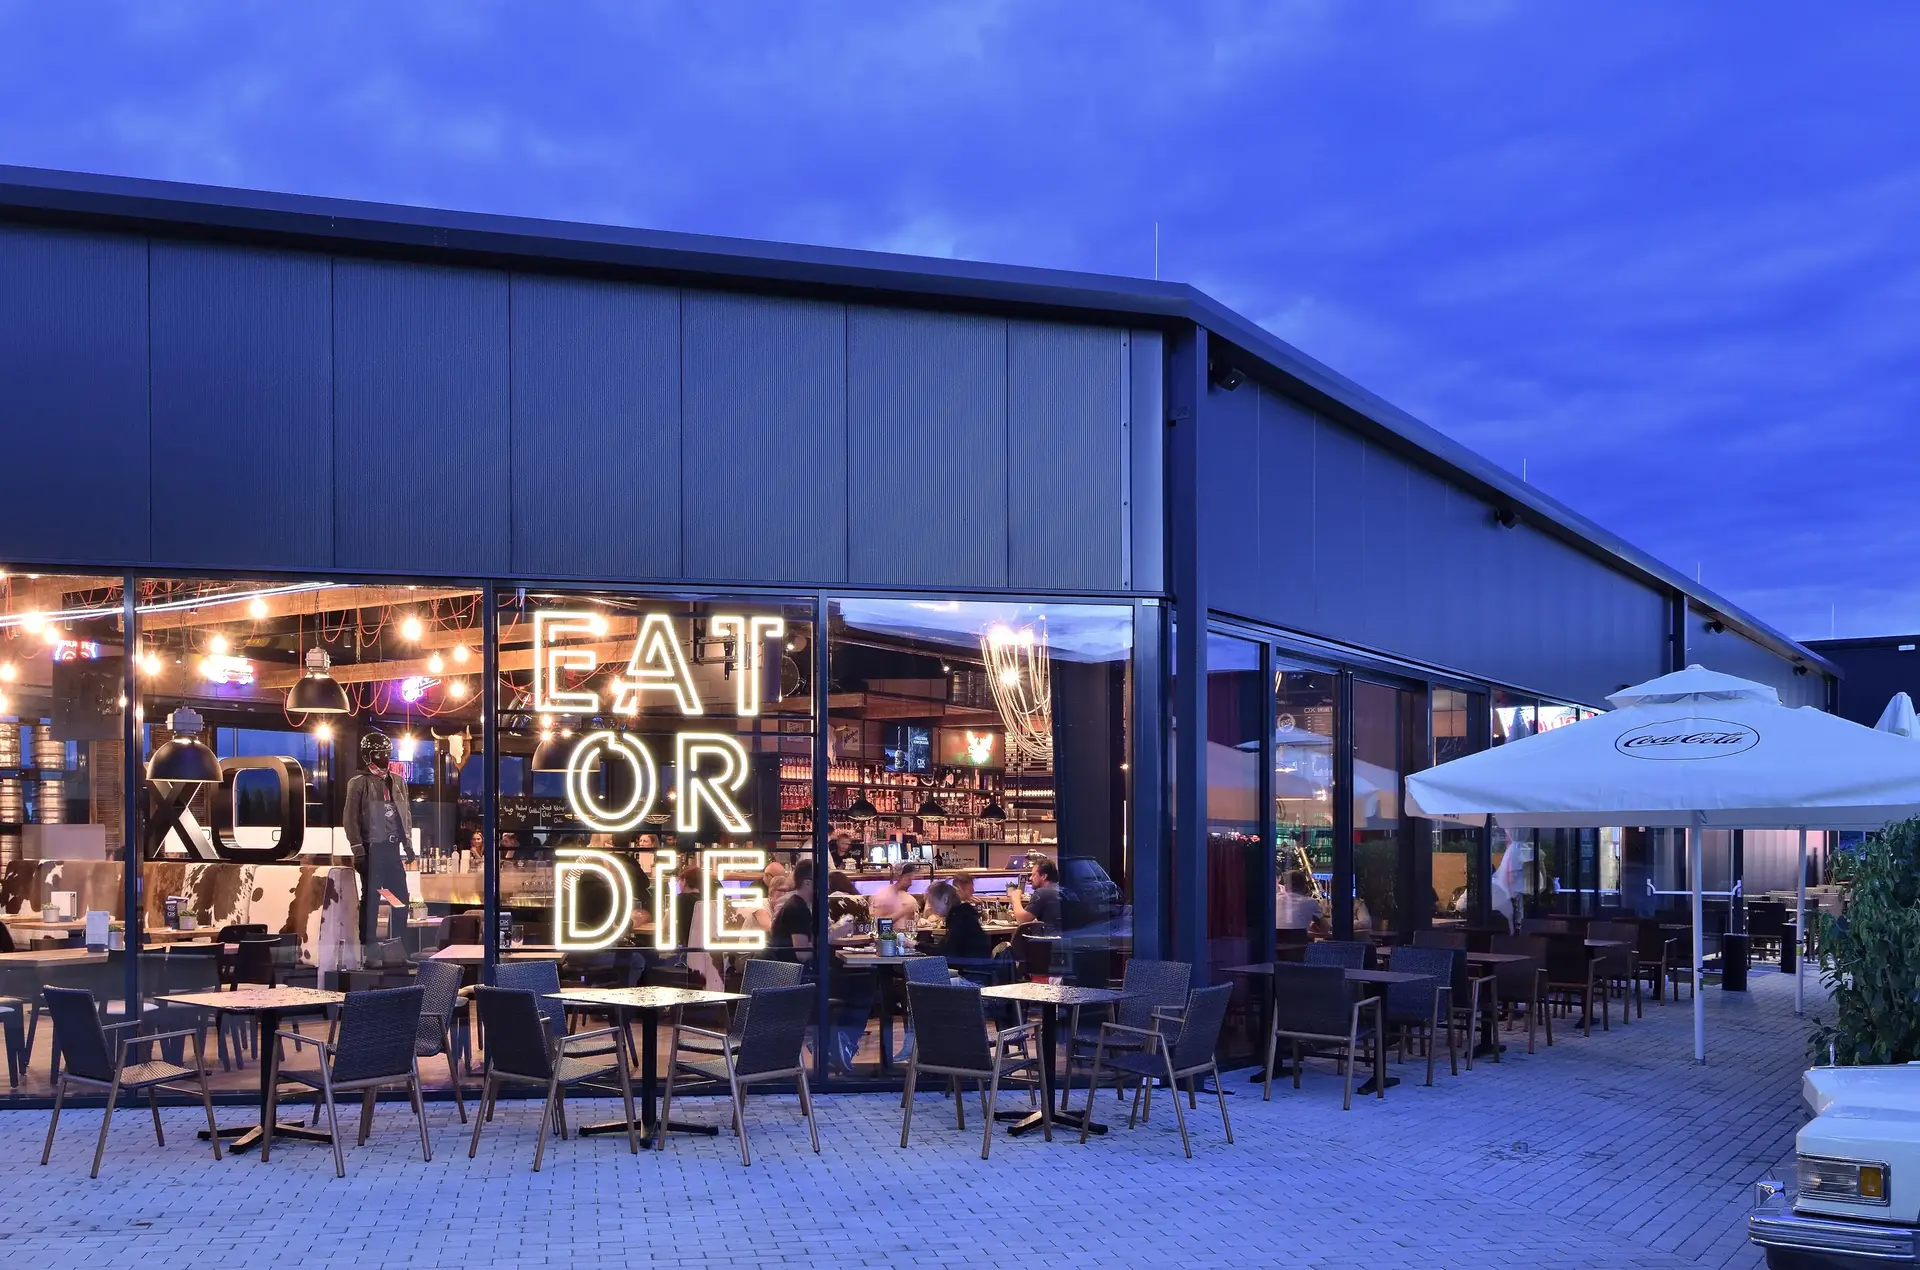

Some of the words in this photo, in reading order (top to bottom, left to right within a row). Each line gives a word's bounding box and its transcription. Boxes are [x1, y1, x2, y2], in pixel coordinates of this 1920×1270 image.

[534, 611, 784, 716] EAT
[566, 732, 752, 832] OR
[1623, 731, 1750, 748] Coca-Cola
[555, 850, 766, 950] DIE
